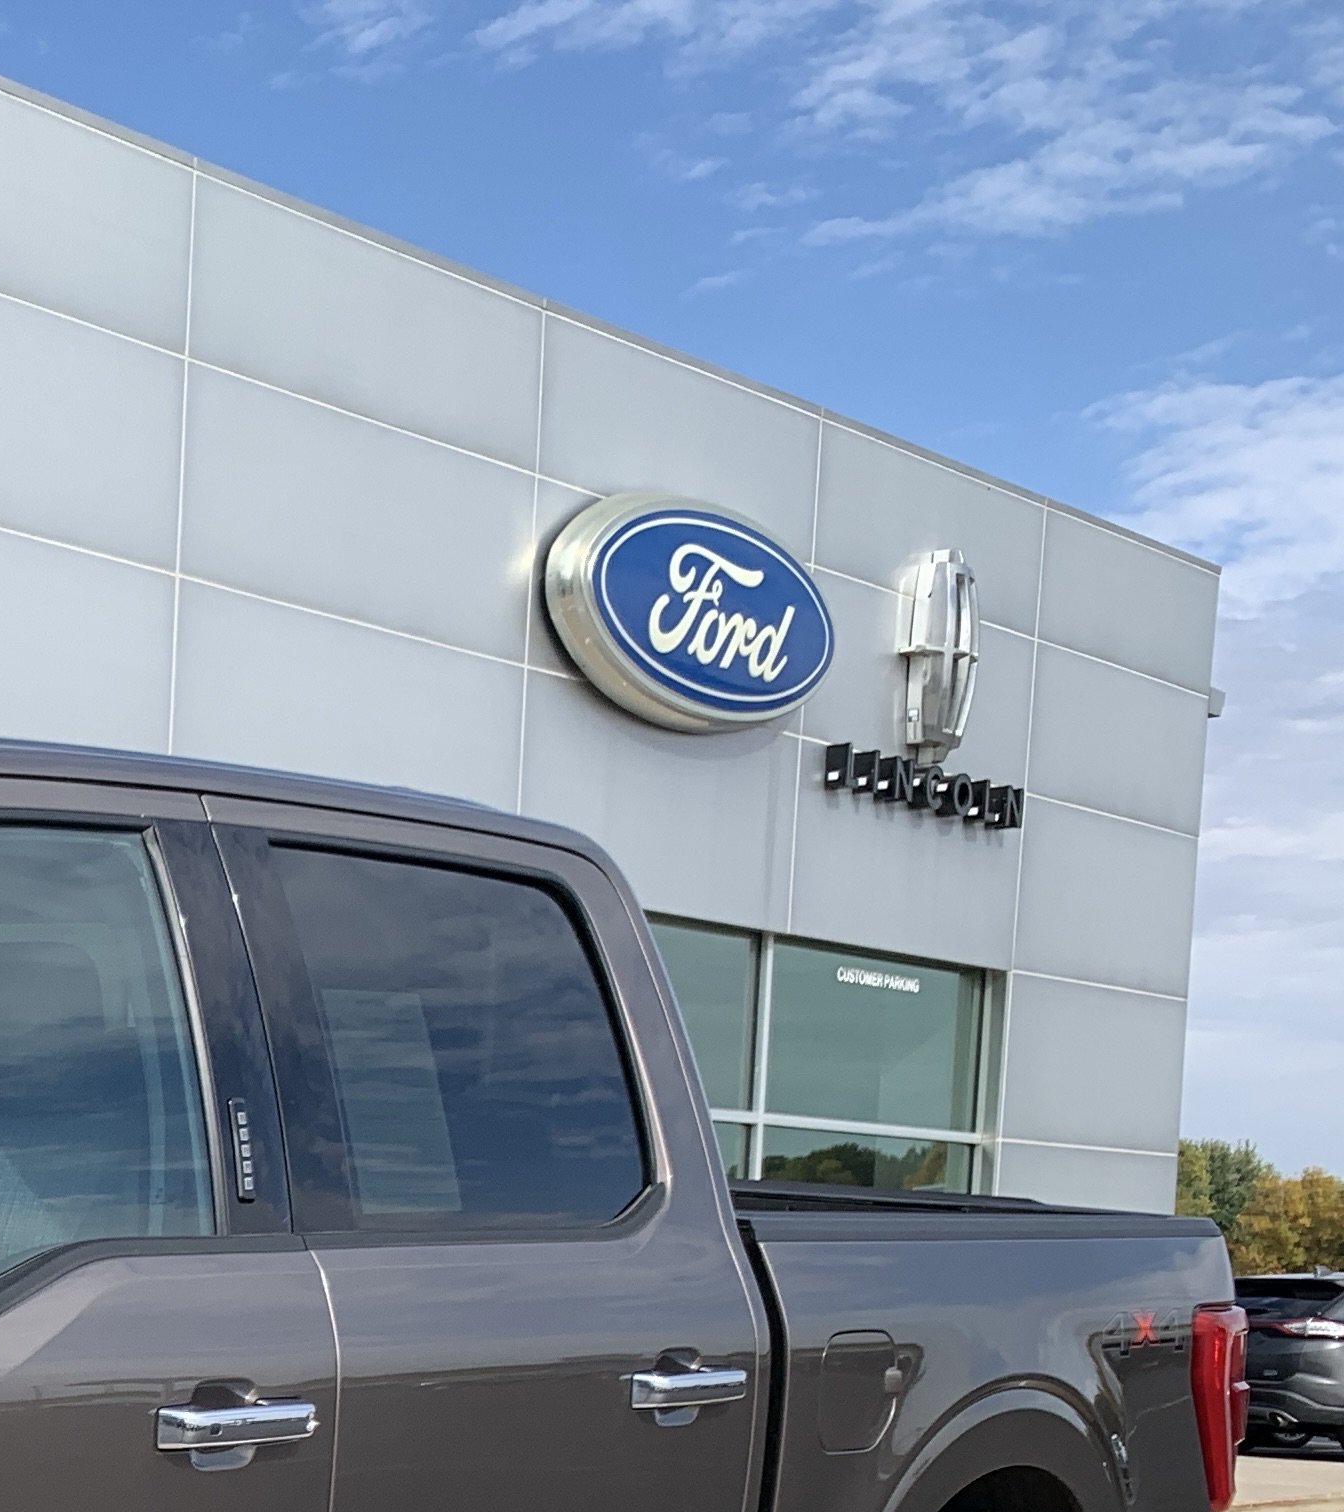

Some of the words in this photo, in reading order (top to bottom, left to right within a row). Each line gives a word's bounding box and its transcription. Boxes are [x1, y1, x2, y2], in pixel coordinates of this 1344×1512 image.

[649, 543, 795, 682] Ford
[836, 966, 883, 988] CUSTOMER
[883, 974, 920, 994] PARKING
